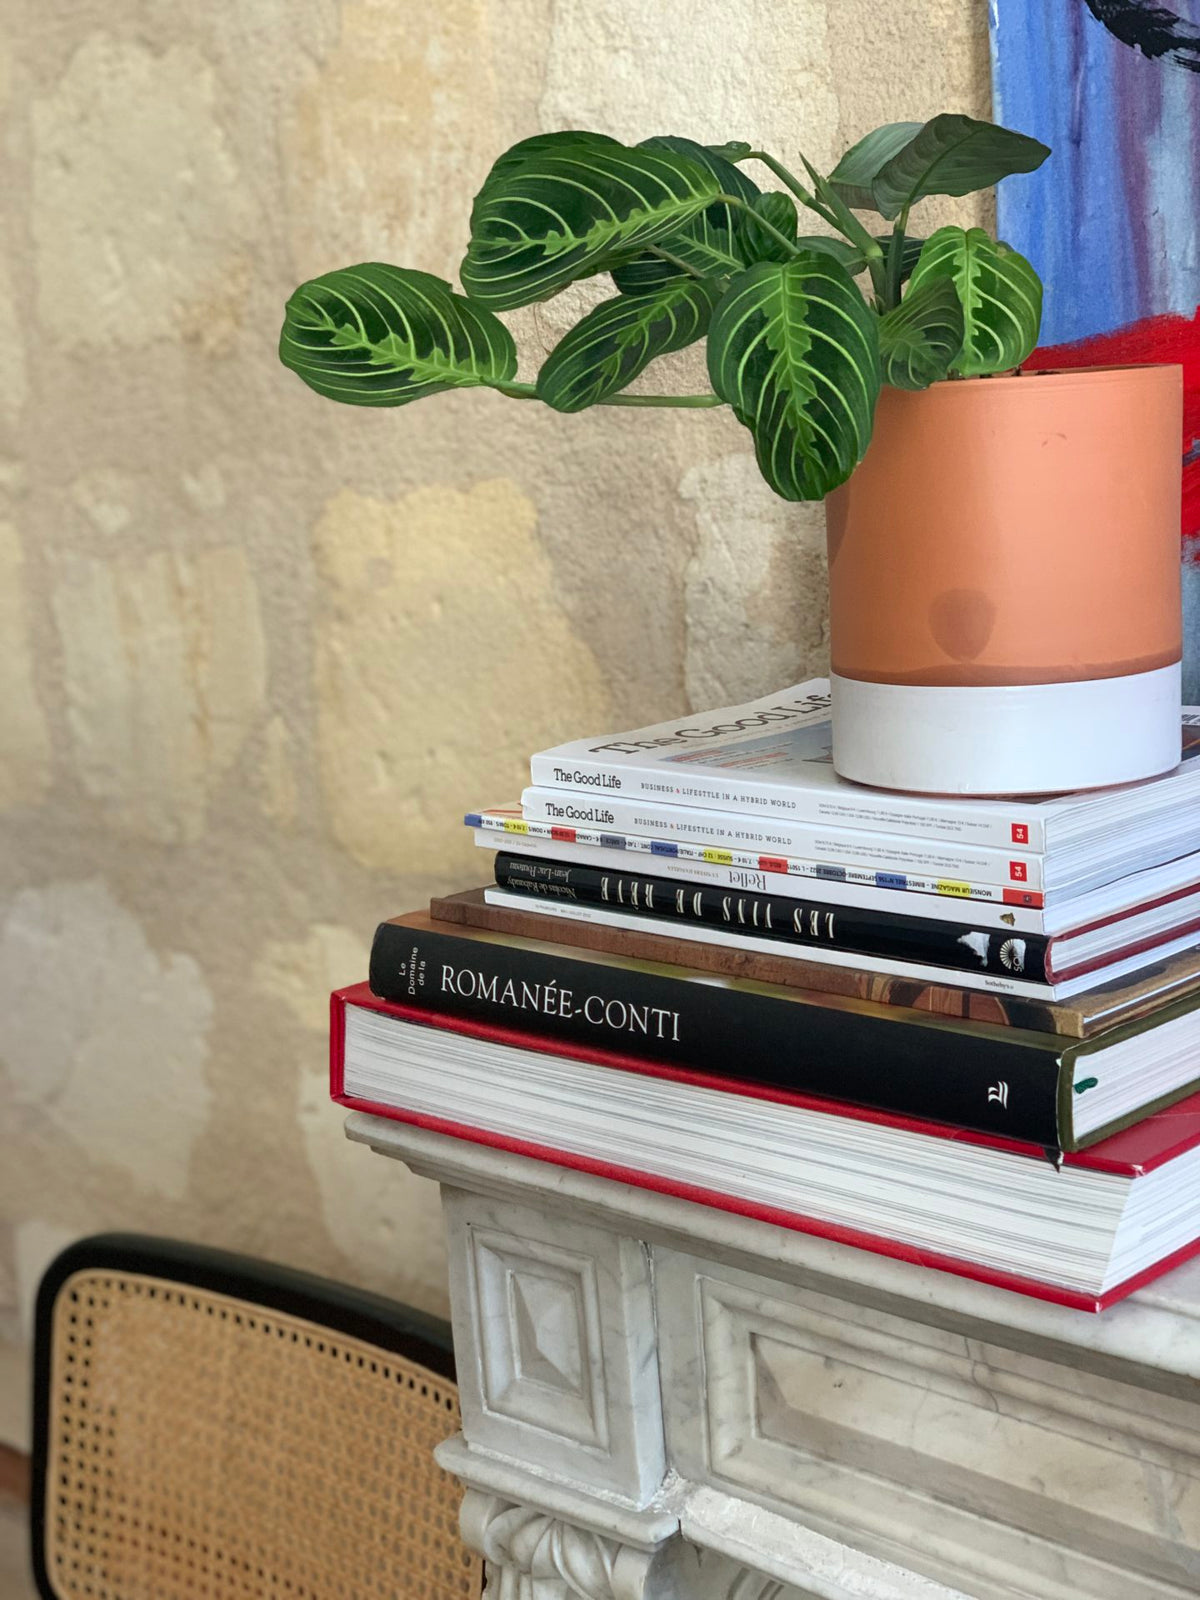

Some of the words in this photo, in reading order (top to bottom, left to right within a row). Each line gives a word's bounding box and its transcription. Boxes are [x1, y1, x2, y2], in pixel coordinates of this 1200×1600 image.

[588, 737, 687, 754] The
[675, 712, 797, 738] Good
[771, 694, 831, 713] Lif
[553, 768, 572, 782] The
[573, 770, 600, 787] Good
[602, 774, 621, 789] Life
[640, 782, 673, 793] BUSINESS
[682, 787, 719, 799] LIFESTYLE
[722, 792, 730, 800] IN
[740, 795, 767, 805] HYBRID
[770, 799, 796, 809] WORLD
[545, 802, 564, 817] The
[565, 805, 593, 821] Good
[594, 808, 614, 824] Life
[634, 818, 668, 828] BUSINESS
[676, 823, 714, 834] LIFESTYLE
[716, 828, 725, 836] IN
[727, 829, 733, 837] A
[735, 830, 762, 841] HYBRID
[765, 835, 792, 846] WORLD
[1016, 828, 1024, 839] 54
[538, 866, 572, 883] Jean-Luc
[728, 870, 767, 890] Reflet
[1014, 866, 1022, 877] 54
[538, 882, 548, 893] de
[548, 883, 577, 899] Nicolas
[600, 877, 654, 910] RÊVE
[930, 883, 961, 893] MAGAZINE
[962, 887, 992, 897] MONSIEUR
[675, 889, 702, 916] DE
[721, 896, 772, 929] VINS
[792, 907, 835, 939] LES
[399, 962, 407, 976] Le
[408, 946, 419, 995] Domaine
[418, 960, 426, 970] la
[417, 972, 425, 986] de
[984, 979, 1010, 990] Sotheby's
[440, 965, 680, 1041] ROMANÉE-CONTI
